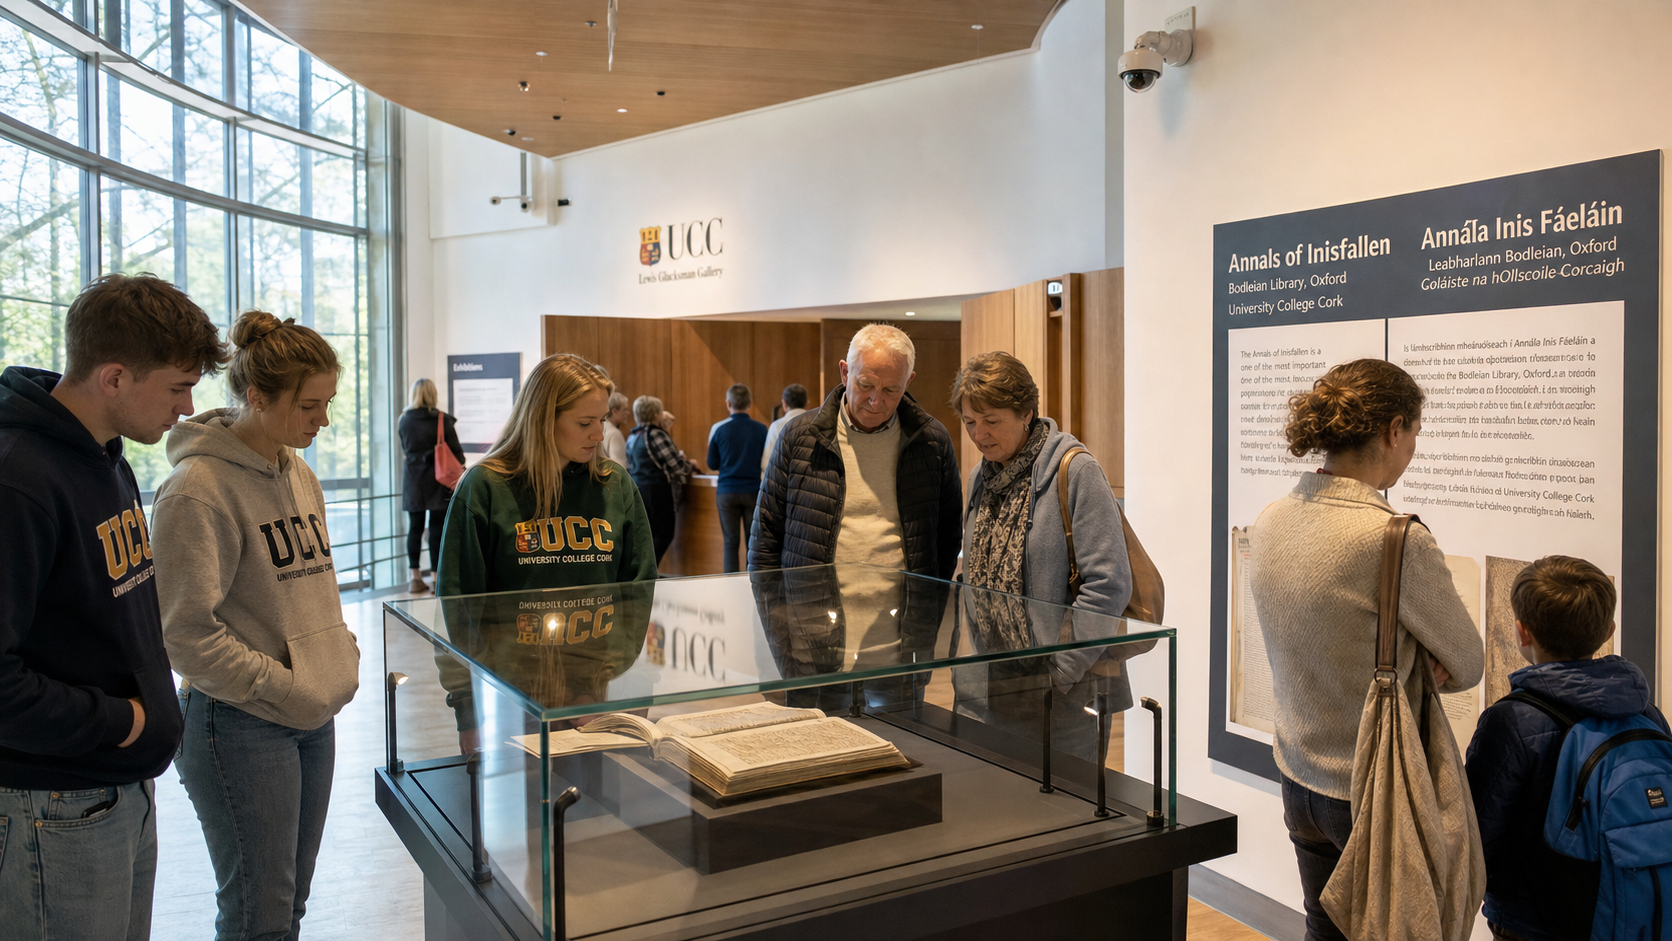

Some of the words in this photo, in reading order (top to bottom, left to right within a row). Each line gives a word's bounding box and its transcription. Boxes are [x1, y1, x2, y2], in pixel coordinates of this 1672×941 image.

[1495, 213, 1534, 240] Inis
[1540, 200, 1623, 235] Fáeláin
[667, 217, 723, 261] UCC
[1228, 248, 1281, 273] Annals
[1285, 243, 1303, 267] of
[1307, 235, 1391, 265] Inisfallen
[1429, 252, 1501, 272] Leabharlann
[1505, 245, 1566, 263] Bodleian,
[1570, 236, 1617, 256] Oxford
[639, 272, 657, 284] Lewis
[697, 265, 723, 279] Gallery
[1228, 281, 1267, 294] Bodleian
[1270, 277, 1307, 291] Library,
[1310, 271, 1347, 287] Oxford
[1472, 274, 1487, 286] na
[1228, 301, 1274, 316] University
[1277, 298, 1315, 313] College
[1317, 294, 1344, 308] Cork
[1241, 350, 1251, 358] The
[1252, 350, 1271, 358] Annals
[1281, 347, 1308, 356] Inisfallen
[1310, 347, 1316, 355] is
[1543, 337, 1557, 346] Inis
[1253, 362, 1261, 371] of
[1292, 361, 1326, 371] important
[1459, 370, 1490, 379] Bodleian
[1492, 369, 1520, 381] Library,
[1503, 487, 1541, 501] University
[1542, 490, 1573, 503] College
[1575, 493, 1595, 504] Cork
[96, 508, 153, 581] UCC
[259, 513, 331, 569] UCC
[536, 516, 614, 552] UCC
[518, 555, 560, 565] UNIVERSITY
[562, 554, 595, 563] COLLEGE
